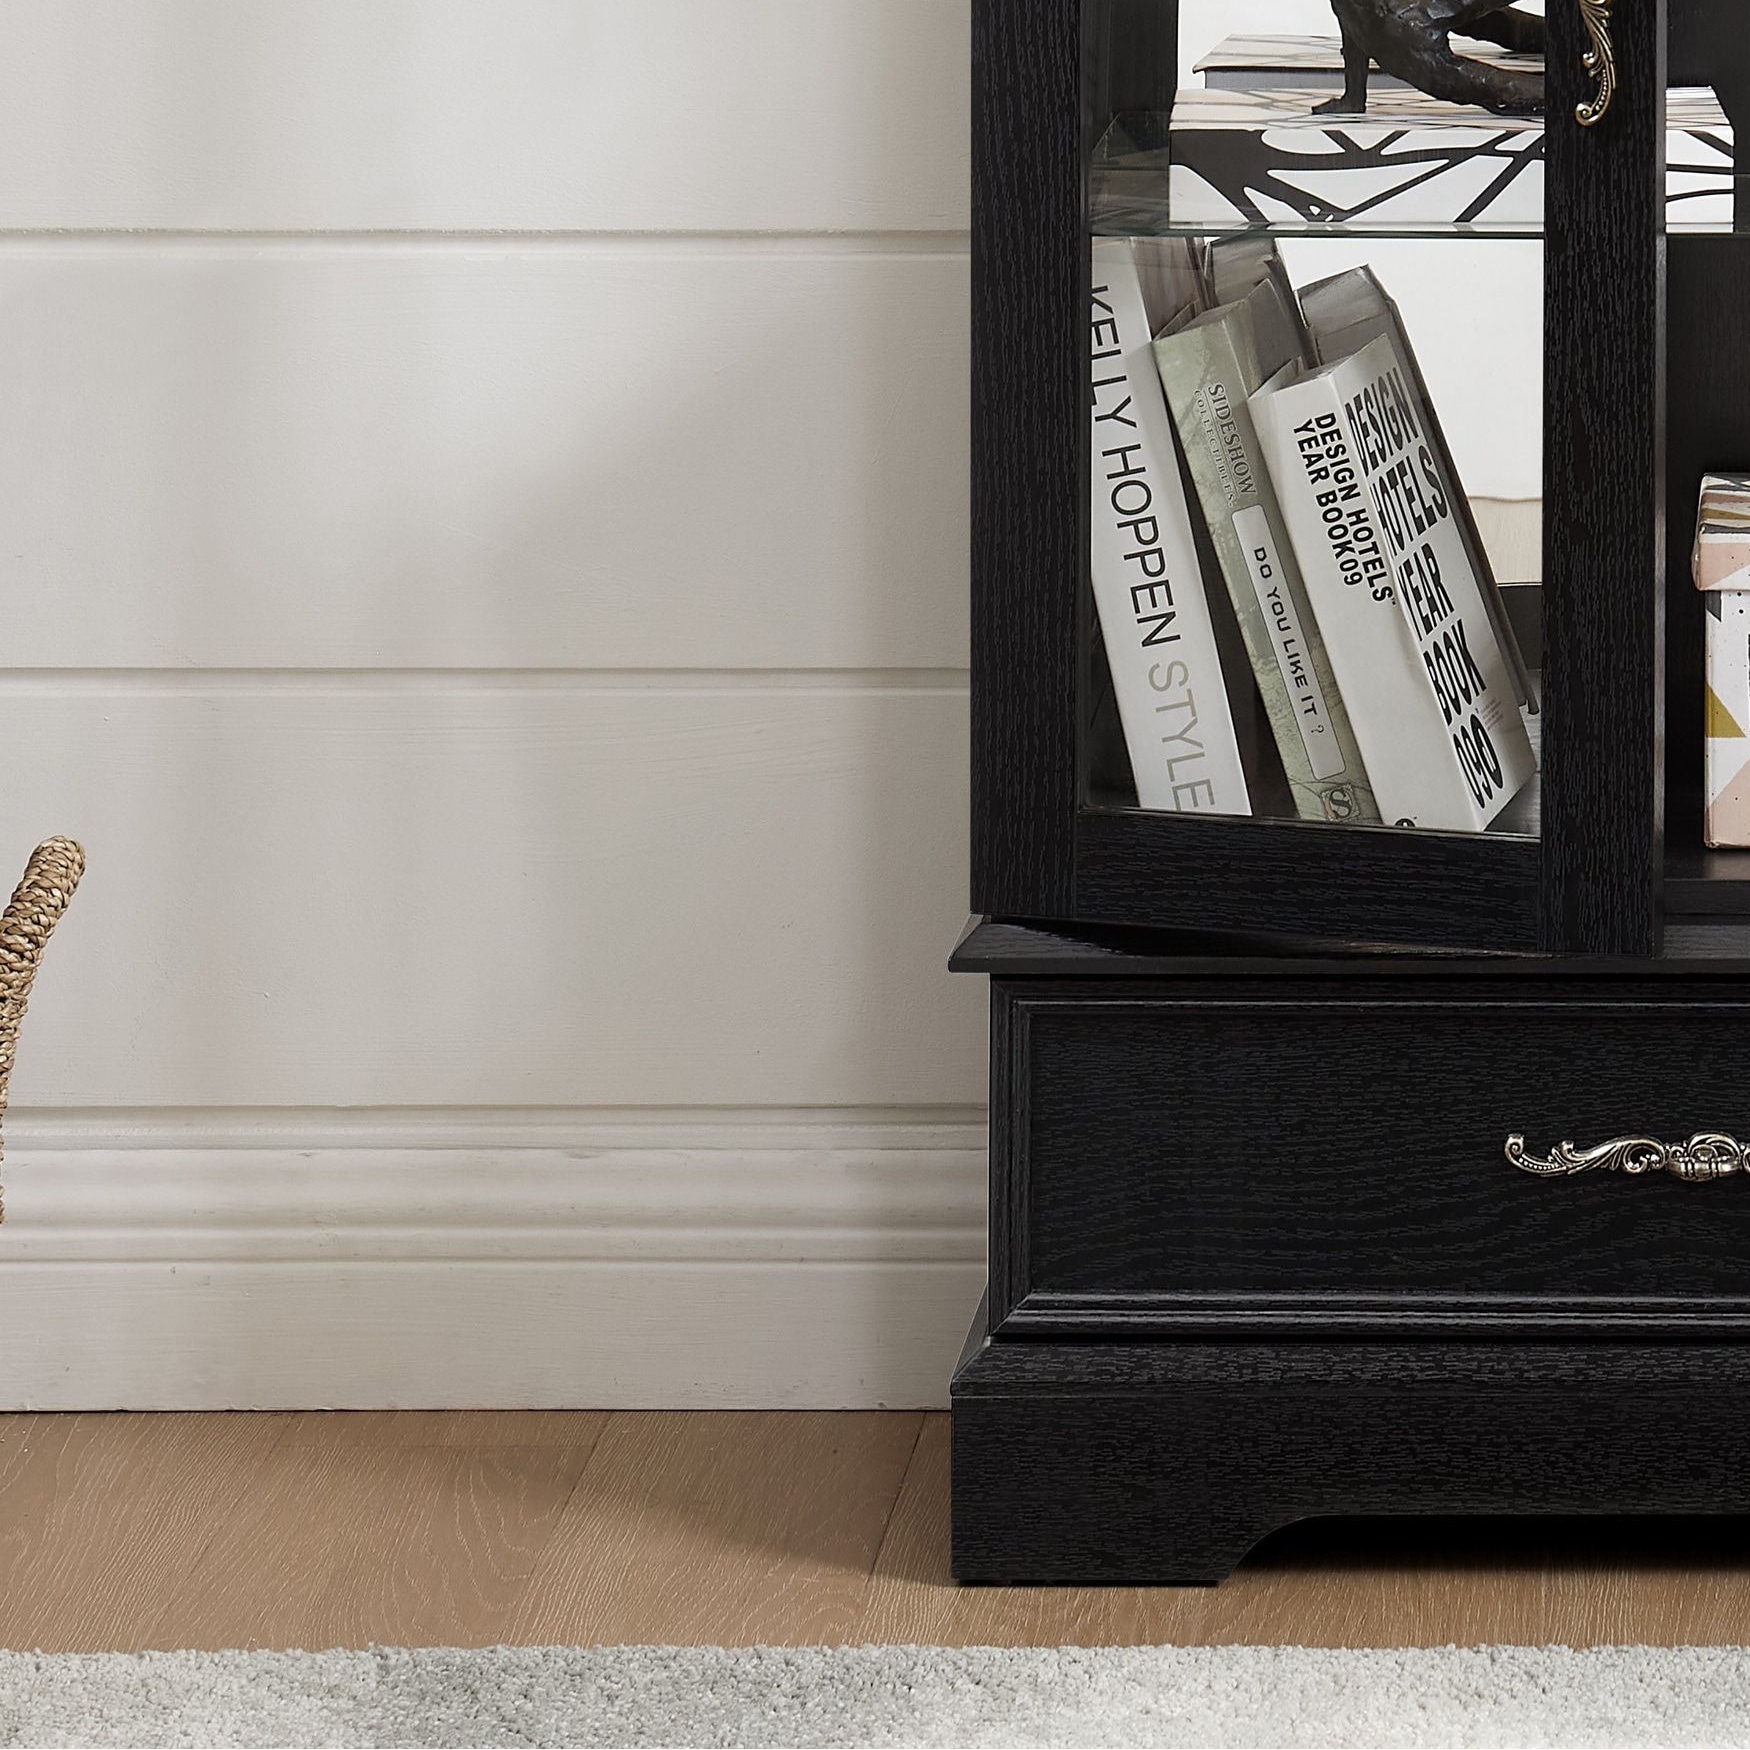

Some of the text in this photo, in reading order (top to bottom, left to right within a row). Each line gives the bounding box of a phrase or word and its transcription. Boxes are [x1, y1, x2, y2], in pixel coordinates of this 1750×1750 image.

[1208, 384, 1256, 494] SIDESHOW
[1294, 419, 1330, 485] YEAR
[1314, 412, 1361, 501] DESIGN
[1345, 367, 1419, 478] DESIGN
[1370, 445, 1448, 559] HOTELS
[1102, 443, 1182, 647] HOPPEN
[1148, 660, 1215, 811] STYLE
[1254, 547, 1273, 580] DO
[1267, 586, 1291, 632] YOU
[1283, 638, 1309, 689] LIKE
[1301, 695, 1318, 716] IT
[1395, 542, 1455, 642] YEAR
[1423, 618, 1487, 726] BOOK
